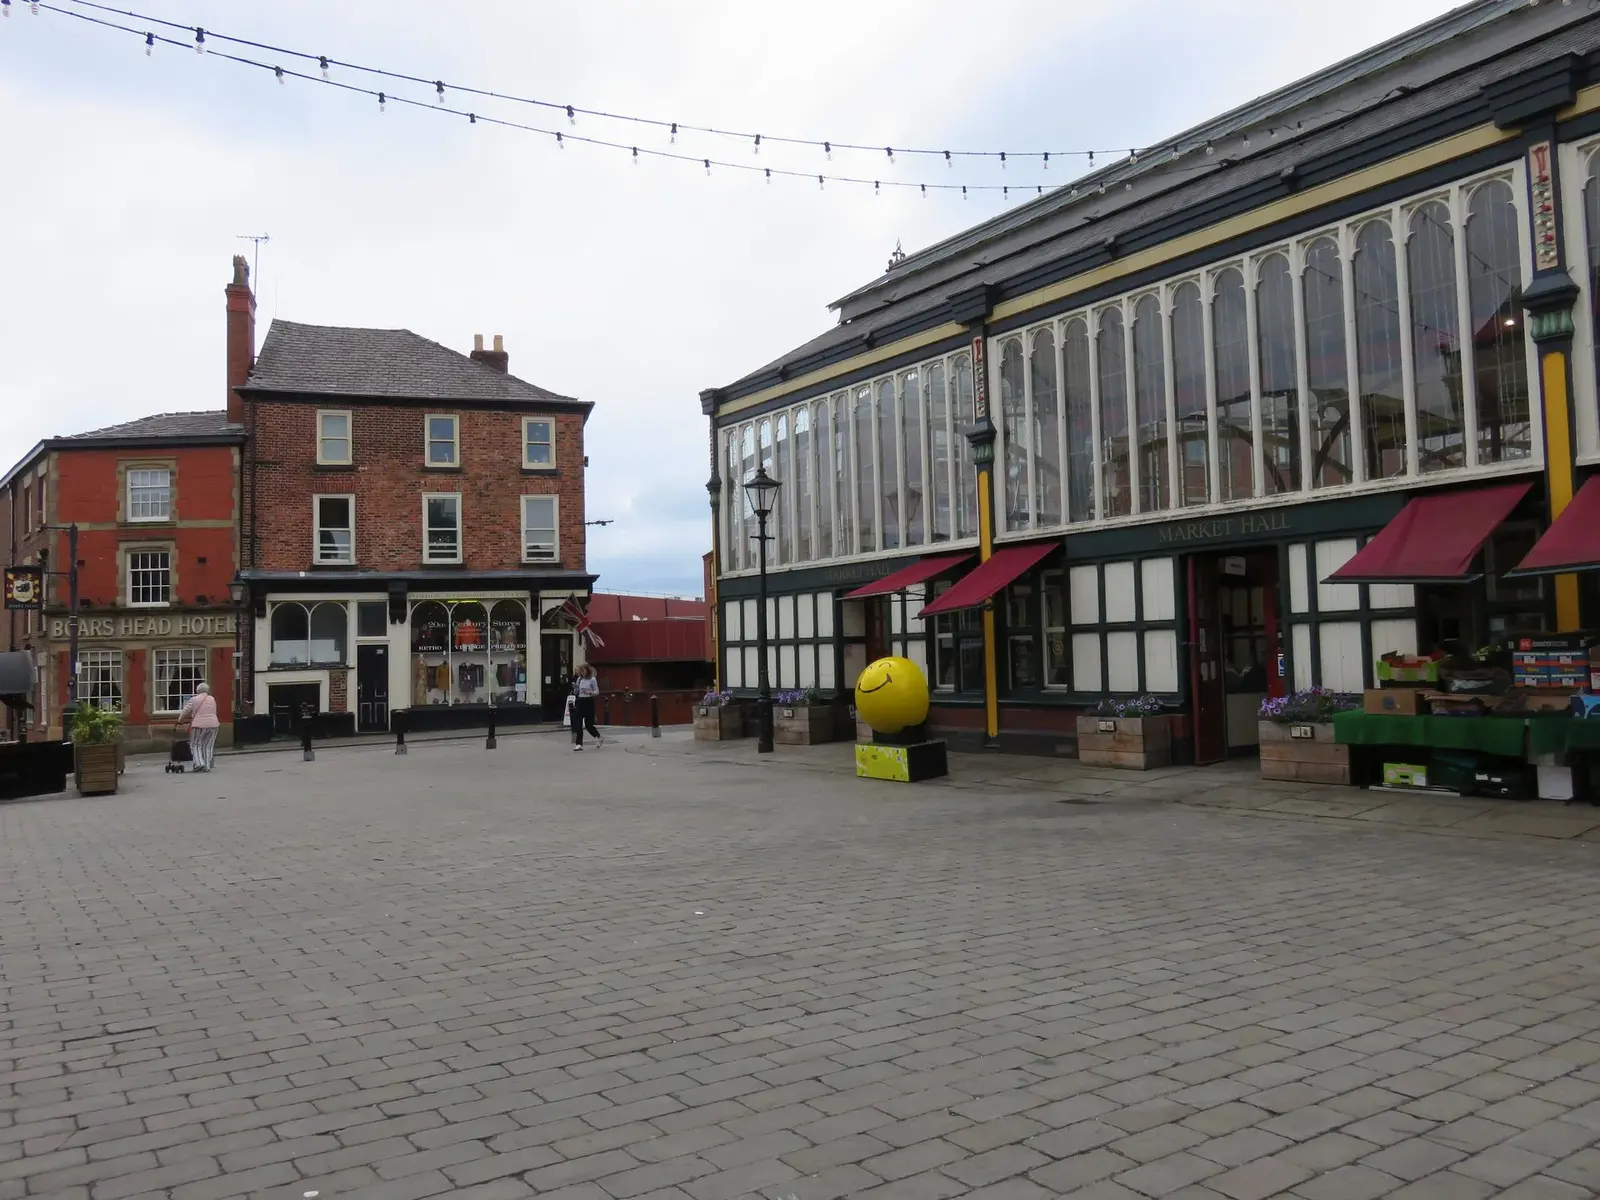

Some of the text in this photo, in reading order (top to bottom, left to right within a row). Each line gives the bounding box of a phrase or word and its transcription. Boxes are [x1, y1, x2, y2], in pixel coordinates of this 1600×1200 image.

[1159, 513, 1291, 542] MARKET HALL
[121, 618, 172, 635] HEAD
[179, 616, 236, 635] HOTEL
[492, 619, 521, 627] Stores
